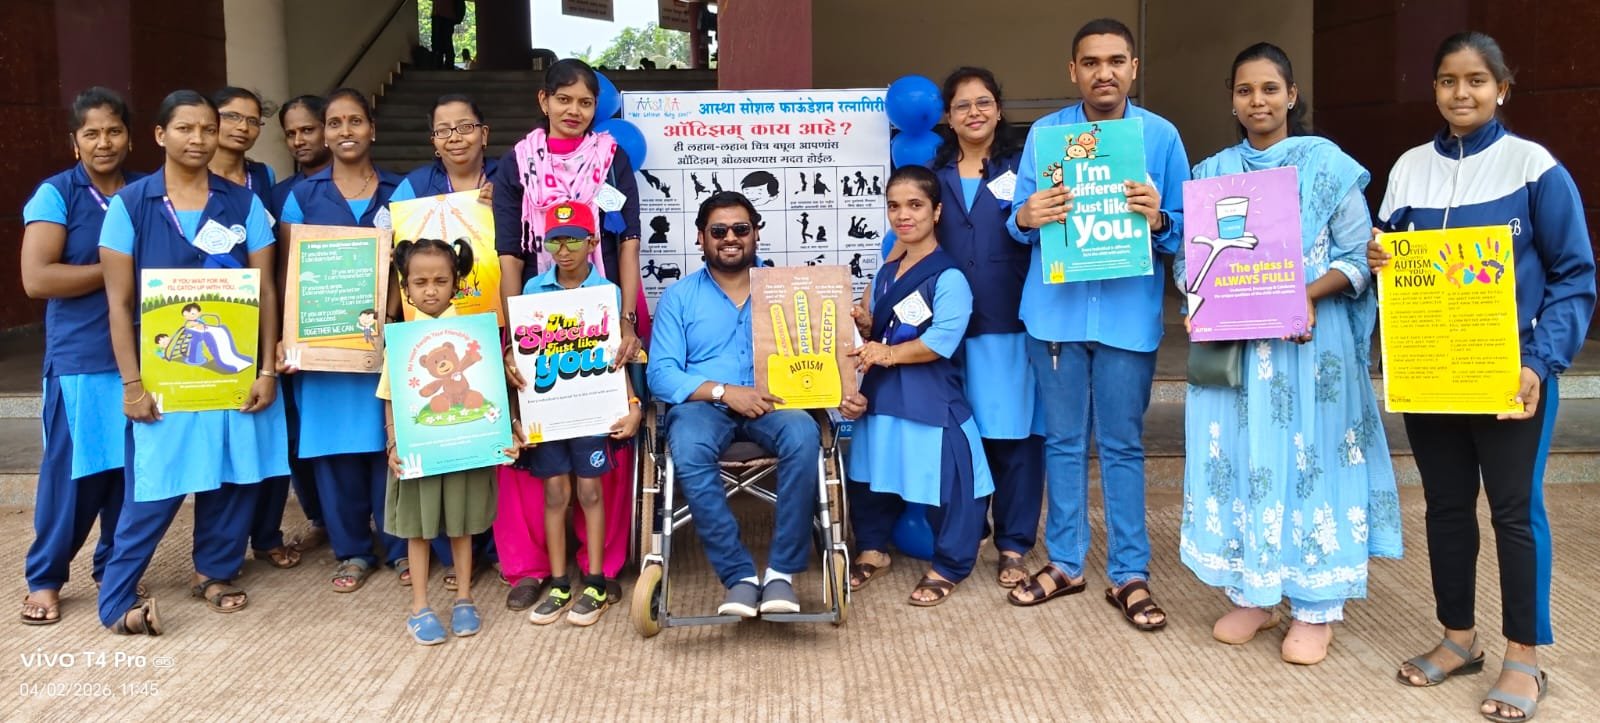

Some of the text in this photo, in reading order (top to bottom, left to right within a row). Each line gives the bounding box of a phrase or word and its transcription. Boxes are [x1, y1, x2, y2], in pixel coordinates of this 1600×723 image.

[698, 96, 885, 115] आस्था सोशल फाऊंडेशन रत्नागिरी
[663, 120, 745, 140] ऑटिझम्
[751, 124, 791, 136] काय
[673, 141, 684, 152] ही
[687, 143, 748, 152] लहान-लहान
[751, 140, 769, 150] चित्र
[799, 139, 840, 149] आपणांस
[677, 154, 718, 167] ऑटिझम्
[721, 154, 777, 164] ओळखण्यास
[780, 155, 804, 163] मदत
[1075, 162, 1111, 182] I'm
[1071, 182, 1127, 197] differen
[1074, 200, 1102, 215] Just
[1390, 239, 1410, 257] 10
[1229, 258, 1295, 274] The glass is
[1394, 259, 1432, 270] AUTISM
[1214, 271, 1295, 288] ALWAYS FULL!
[1394, 274, 1436, 288] KNOW
[303, 324, 355, 336] TOGETHER WE CAN
[546, 313, 579, 331] I'm
[796, 294, 810, 354] APPRECIATE
[514, 310, 610, 355] Special
[822, 312, 833, 354] ACCEPT
[544, 338, 599, 357] Just like
[789, 360, 824, 374] AUTISM
